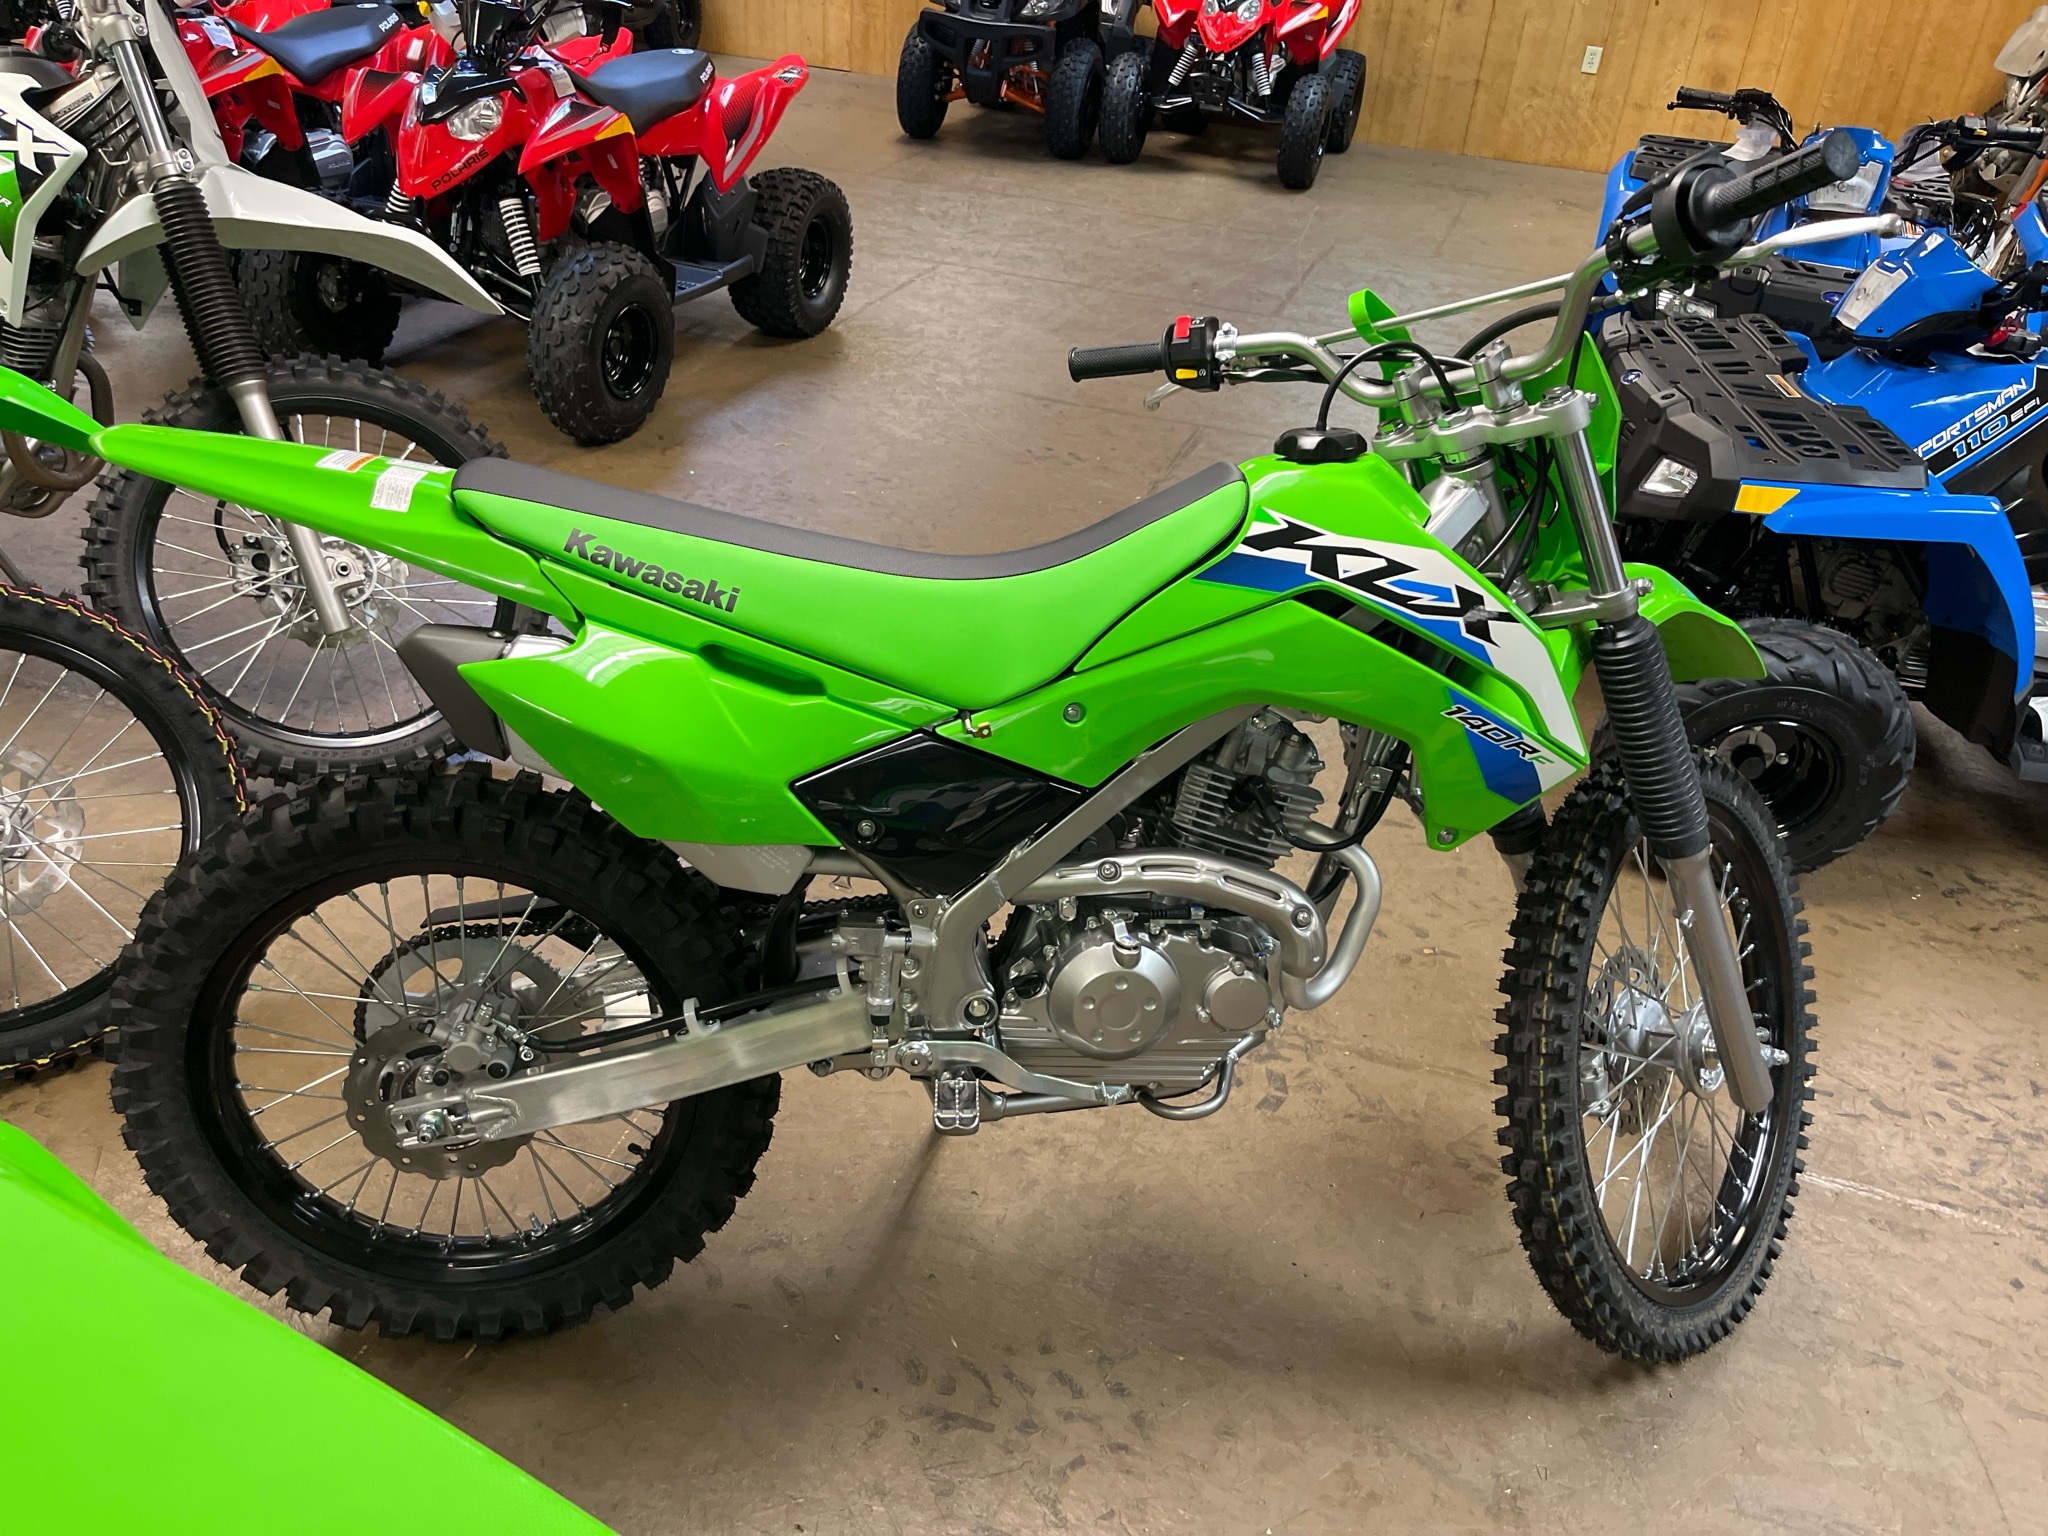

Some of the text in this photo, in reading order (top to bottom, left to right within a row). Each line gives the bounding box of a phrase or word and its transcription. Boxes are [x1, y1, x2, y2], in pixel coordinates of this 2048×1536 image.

[378, 12, 400, 33] POLARIS
[430, 148, 490, 191] POLARIS
[1913, 377, 2028, 459] PORTSMAN
[1952, 396, 2041, 459] 110 EFI
[563, 527, 742, 613] Kawasaki
[1241, 518, 1526, 648] KLX
